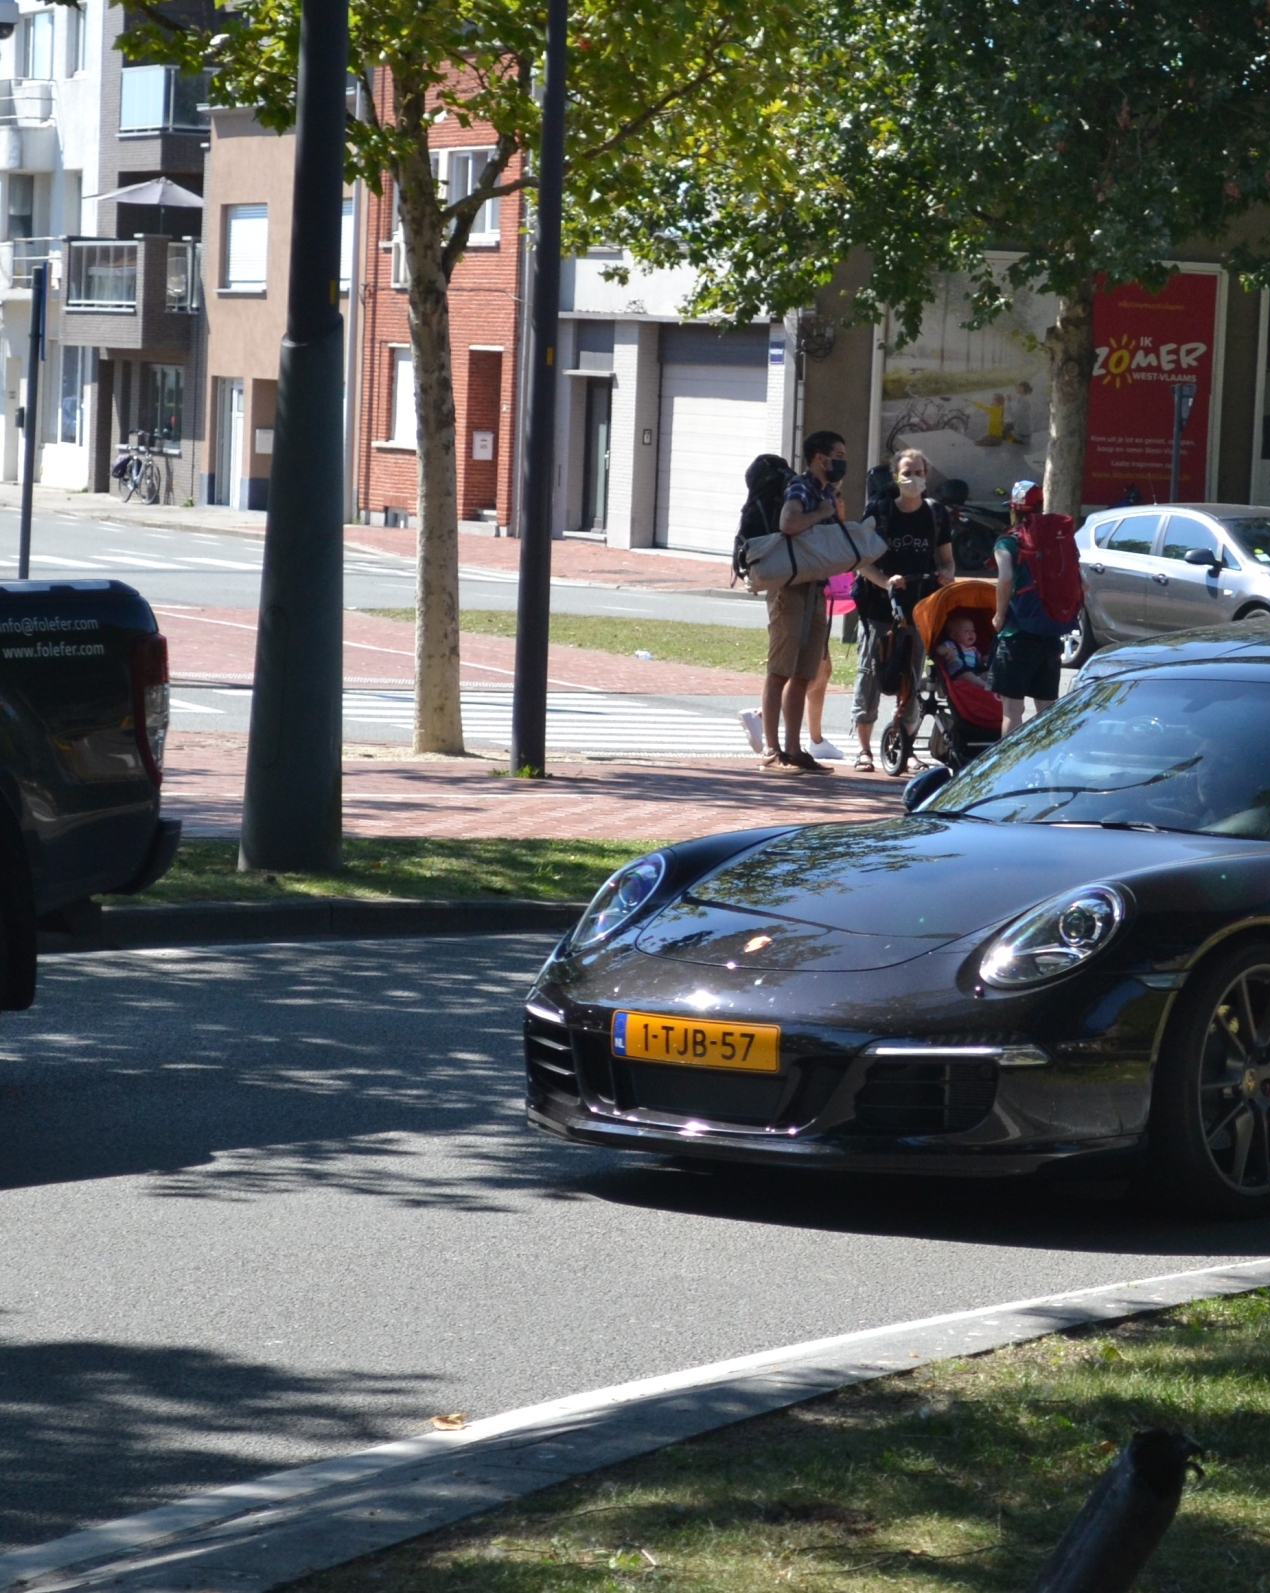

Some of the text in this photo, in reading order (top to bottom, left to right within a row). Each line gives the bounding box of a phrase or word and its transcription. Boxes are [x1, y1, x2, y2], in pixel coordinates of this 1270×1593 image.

[1140, 337, 1153, 347] IK
[1092, 342, 1208, 376] ZOMER
[1132, 371, 1197, 382] WEST-VLAAMS
[2, 641, 105, 659] www.folefer.com
[614, 1038, 625, 1048] NL
[643, 1023, 755, 1062] 1-TJB-57
